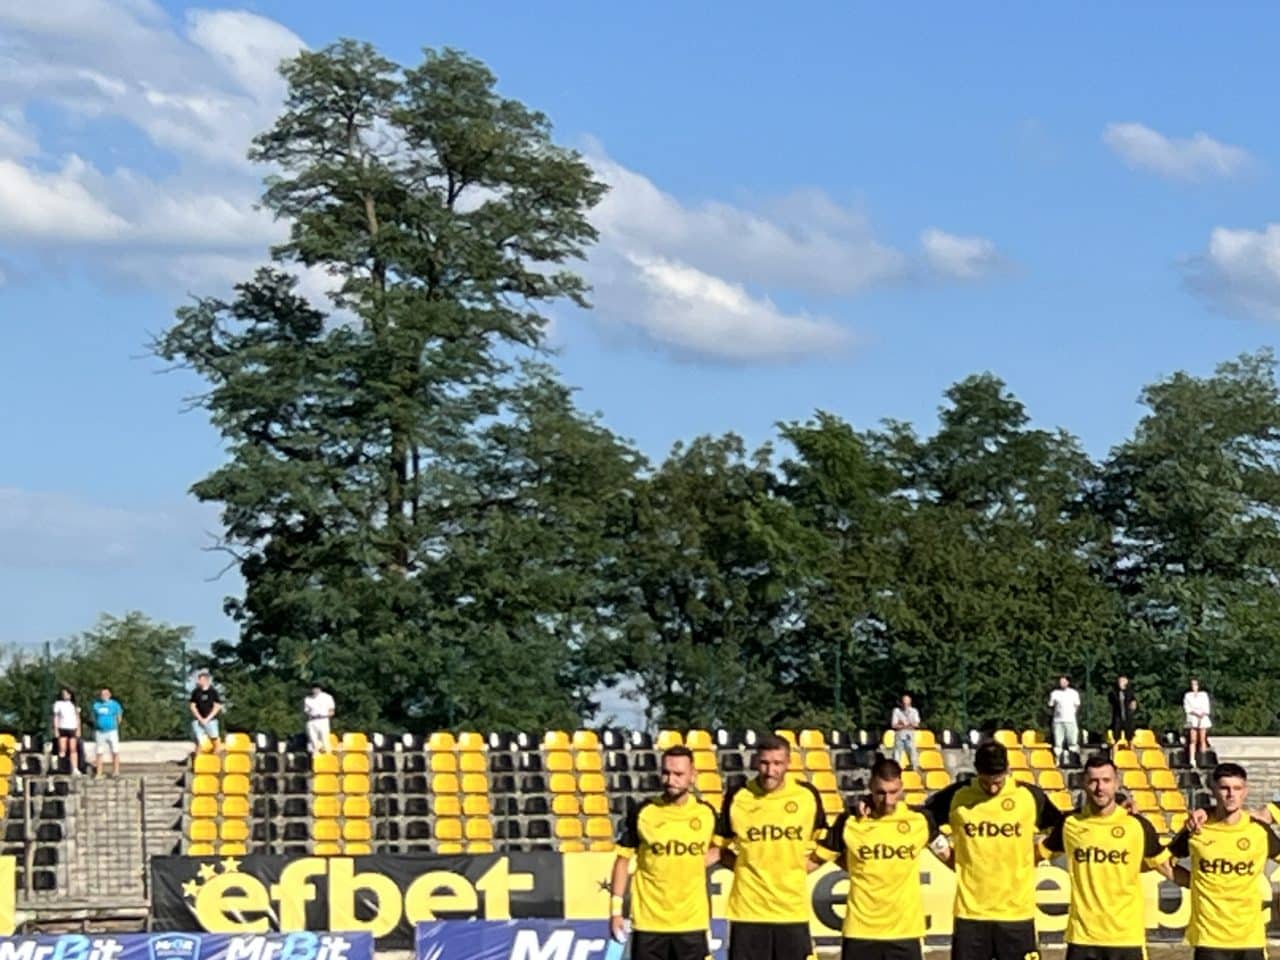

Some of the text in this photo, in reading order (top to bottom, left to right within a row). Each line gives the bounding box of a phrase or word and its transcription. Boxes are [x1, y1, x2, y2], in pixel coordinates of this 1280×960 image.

[746, 824, 804, 842] efbet
[963, 821, 1023, 838] efbet
[650, 840, 707, 857] efbet
[857, 843, 919, 861] efbet
[1073, 846, 1131, 865] efbet
[1199, 857, 1255, 876] efbet
[194, 856, 535, 939] efbet
